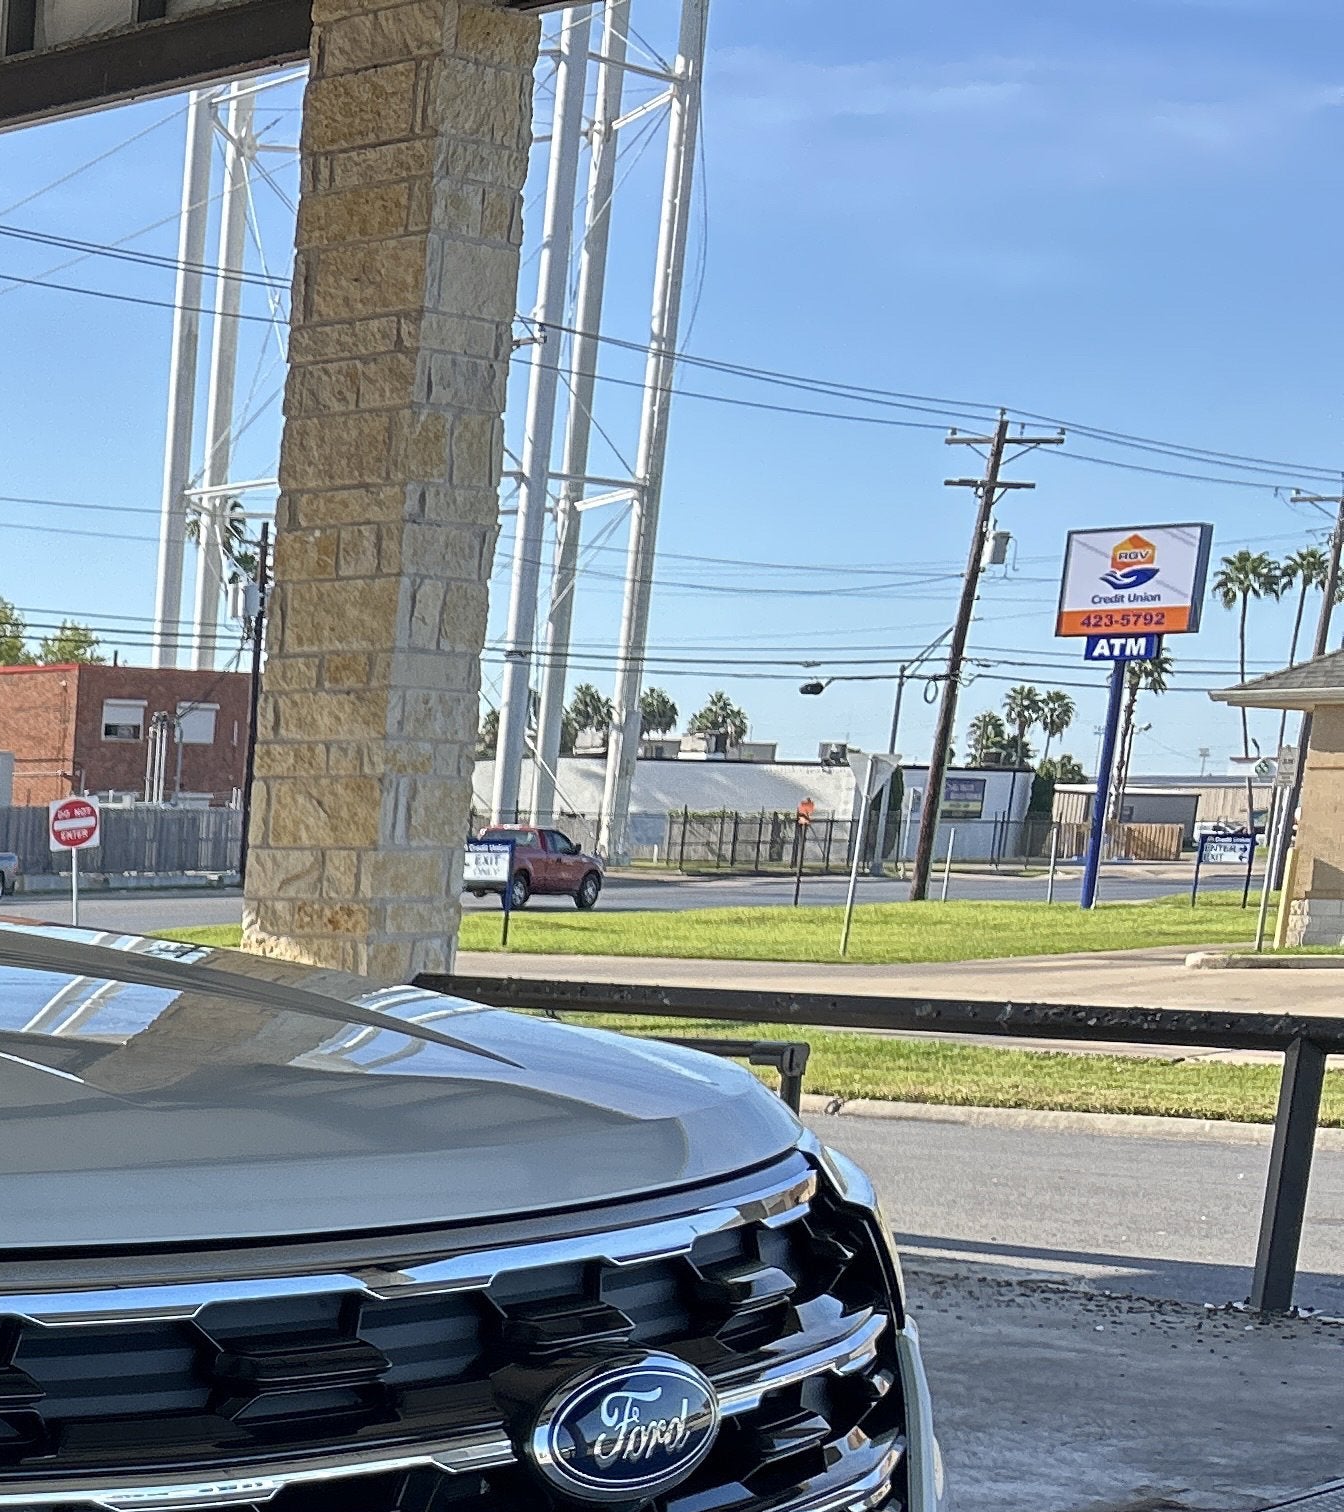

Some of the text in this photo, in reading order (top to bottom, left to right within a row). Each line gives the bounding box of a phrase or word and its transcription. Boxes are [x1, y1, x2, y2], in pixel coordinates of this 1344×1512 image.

[1091, 591, 1161, 605] Credit Union
[1080, 611, 1165, 628] 423-5792
[1092, 637, 1147, 657] ATM
[57, 806, 91, 820] DO NOT
[60, 829, 88, 841] ENTER
[475, 853, 500, 866] EXIT
[593, 1386, 691, 1461] Ford
